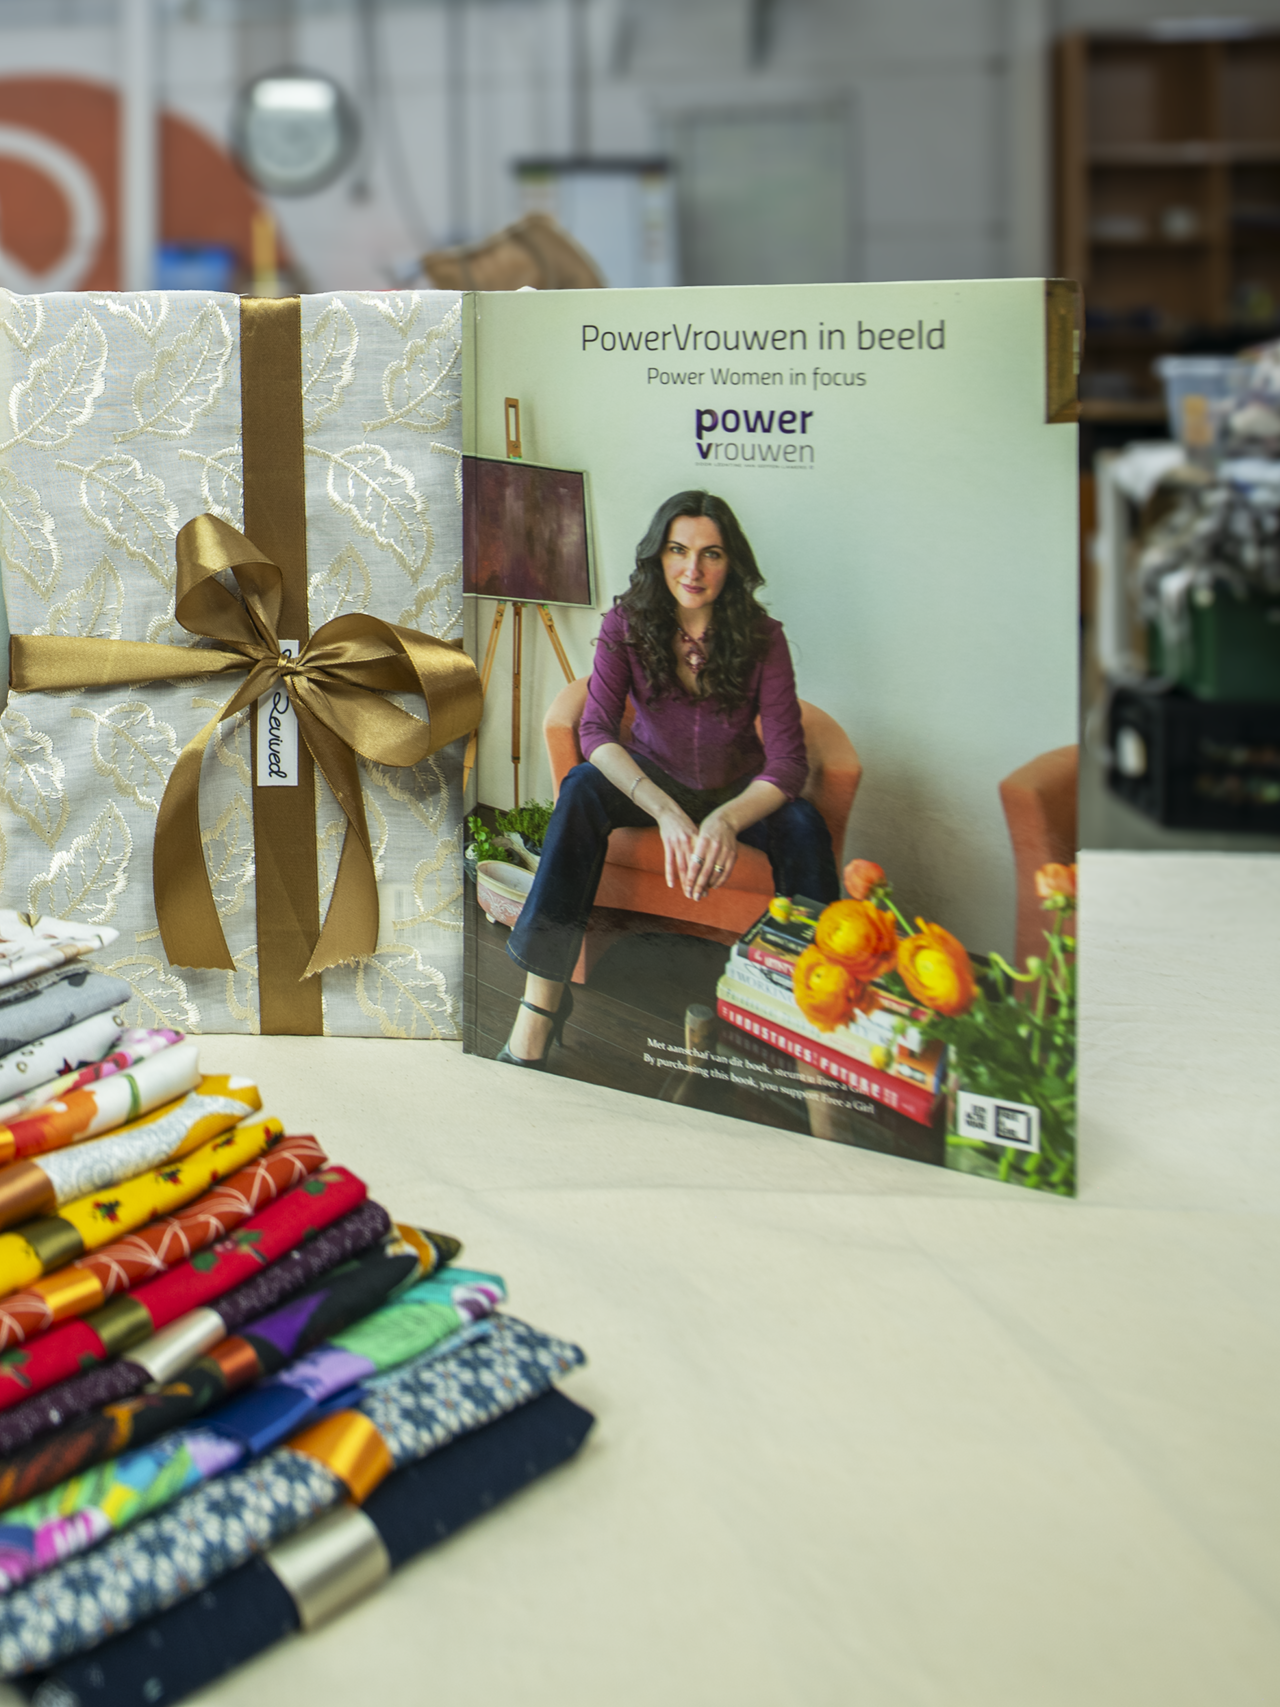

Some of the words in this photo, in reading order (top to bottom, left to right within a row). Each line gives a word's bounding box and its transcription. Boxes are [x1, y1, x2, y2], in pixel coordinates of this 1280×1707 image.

[581, 323, 807, 352] PowerVrouwen
[818, 322, 846, 351] in
[856, 319, 946, 351] beeld
[647, 367, 705, 386] Power
[710, 367, 784, 386] Women
[789, 367, 807, 386] in
[812, 366, 867, 391] focus
[694, 408, 815, 440] power
[695, 441, 815, 463] vrouwen
[646, 1037, 666, 1051] Met
[710, 1053, 729, 1065] van
[643, 1052, 655, 1067] By
[710, 1068, 730, 1081] this
[759, 1081, 780, 1093] you
